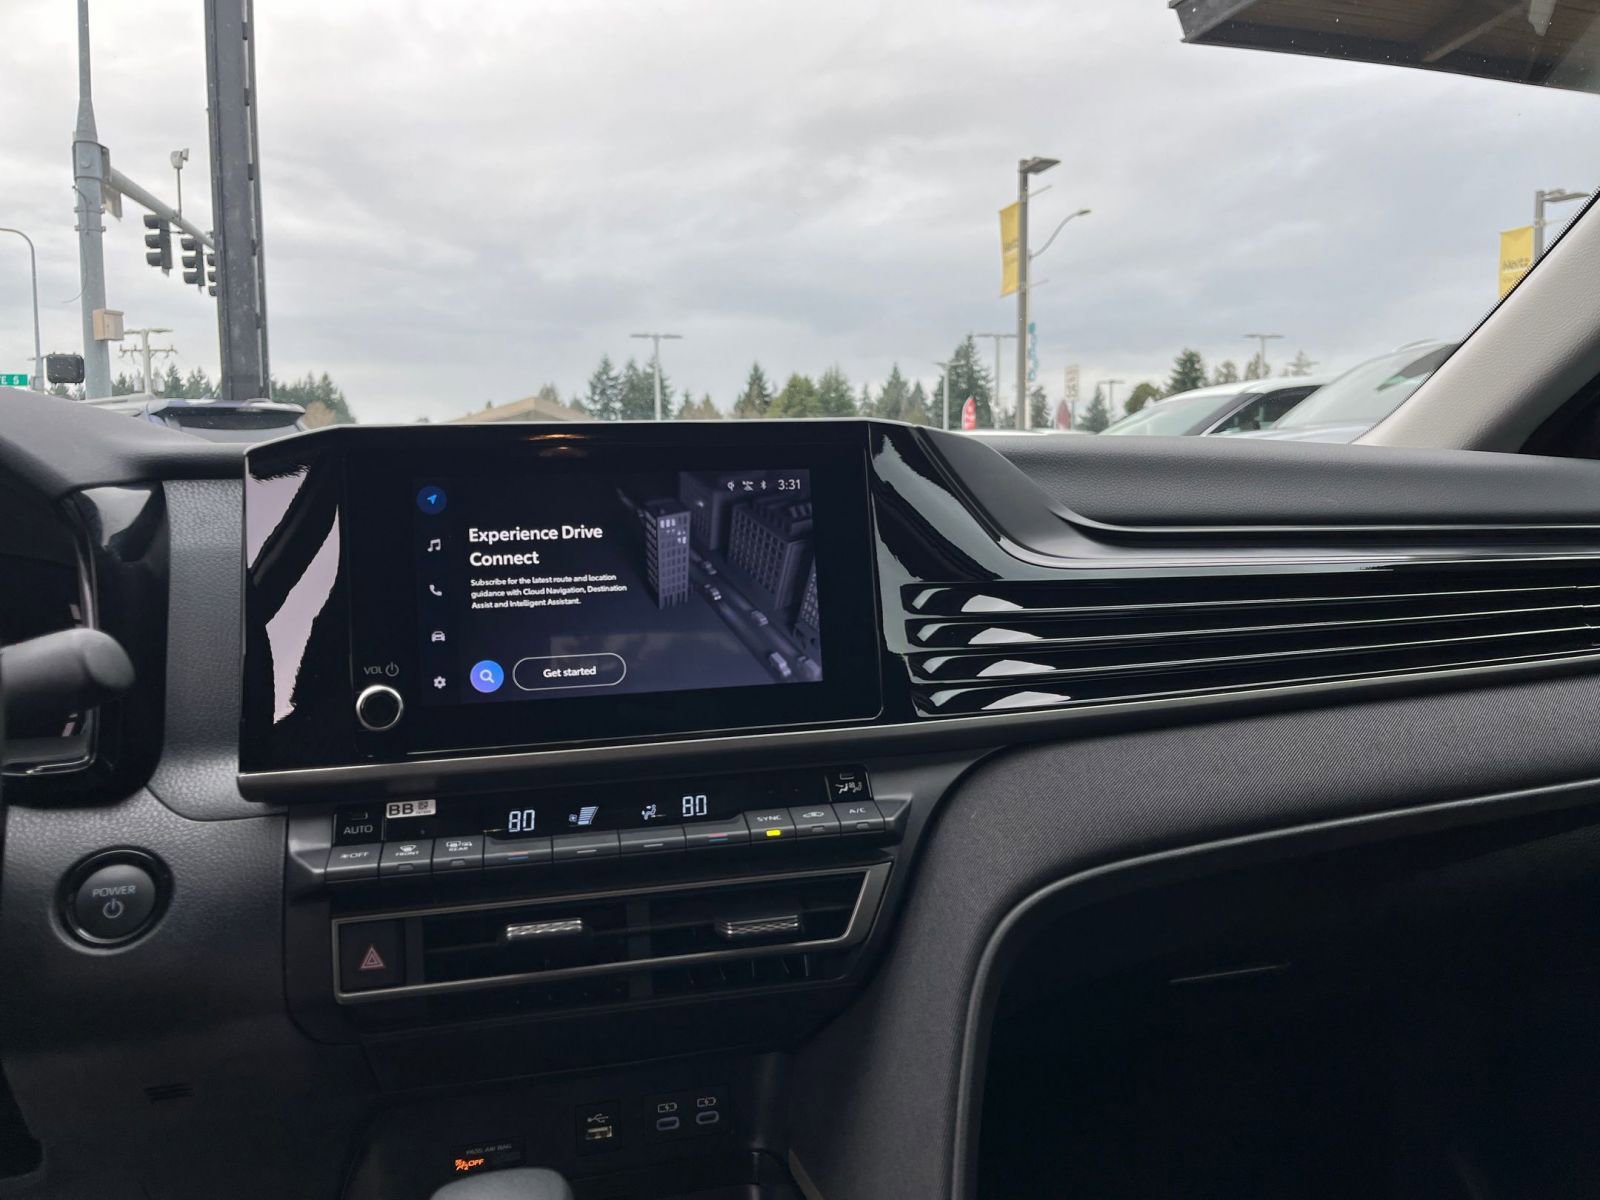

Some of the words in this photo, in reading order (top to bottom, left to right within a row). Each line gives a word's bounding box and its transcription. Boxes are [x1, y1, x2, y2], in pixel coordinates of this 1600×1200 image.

[778, 479, 800, 490] 3:31
[468, 526, 558, 545] Experience
[561, 525, 603, 539] Drive
[469, 551, 540, 567] Connect
[470, 578, 506, 587] Subscribe
[507, 577, 518, 585] for
[532, 576, 552, 584] latest
[573, 574, 588, 582] and
[588, 573, 617, 582] location
[471, 590, 505, 599] guidance
[506, 588, 522, 597] with
[523, 587, 545, 596] Cloud
[546, 586, 586, 595] Navigation,
[587, 585, 628, 593] Destination
[471, 601, 493, 609] Assist
[494, 600, 508, 608] and
[509, 599, 546, 608] Intelligent
[547, 597, 581, 606] Assistant.
[363, 666, 383, 675] VOL
[543, 669, 561, 678] Get
[563, 666, 597, 677] started
[389, 803, 414, 816] BB
[682, 795, 707, 817] 80
[509, 809, 536, 832] 80
[343, 824, 373, 835] AUTO
[92, 885, 136, 897] POWER
[468, 1158, 484, 1166] OFF
